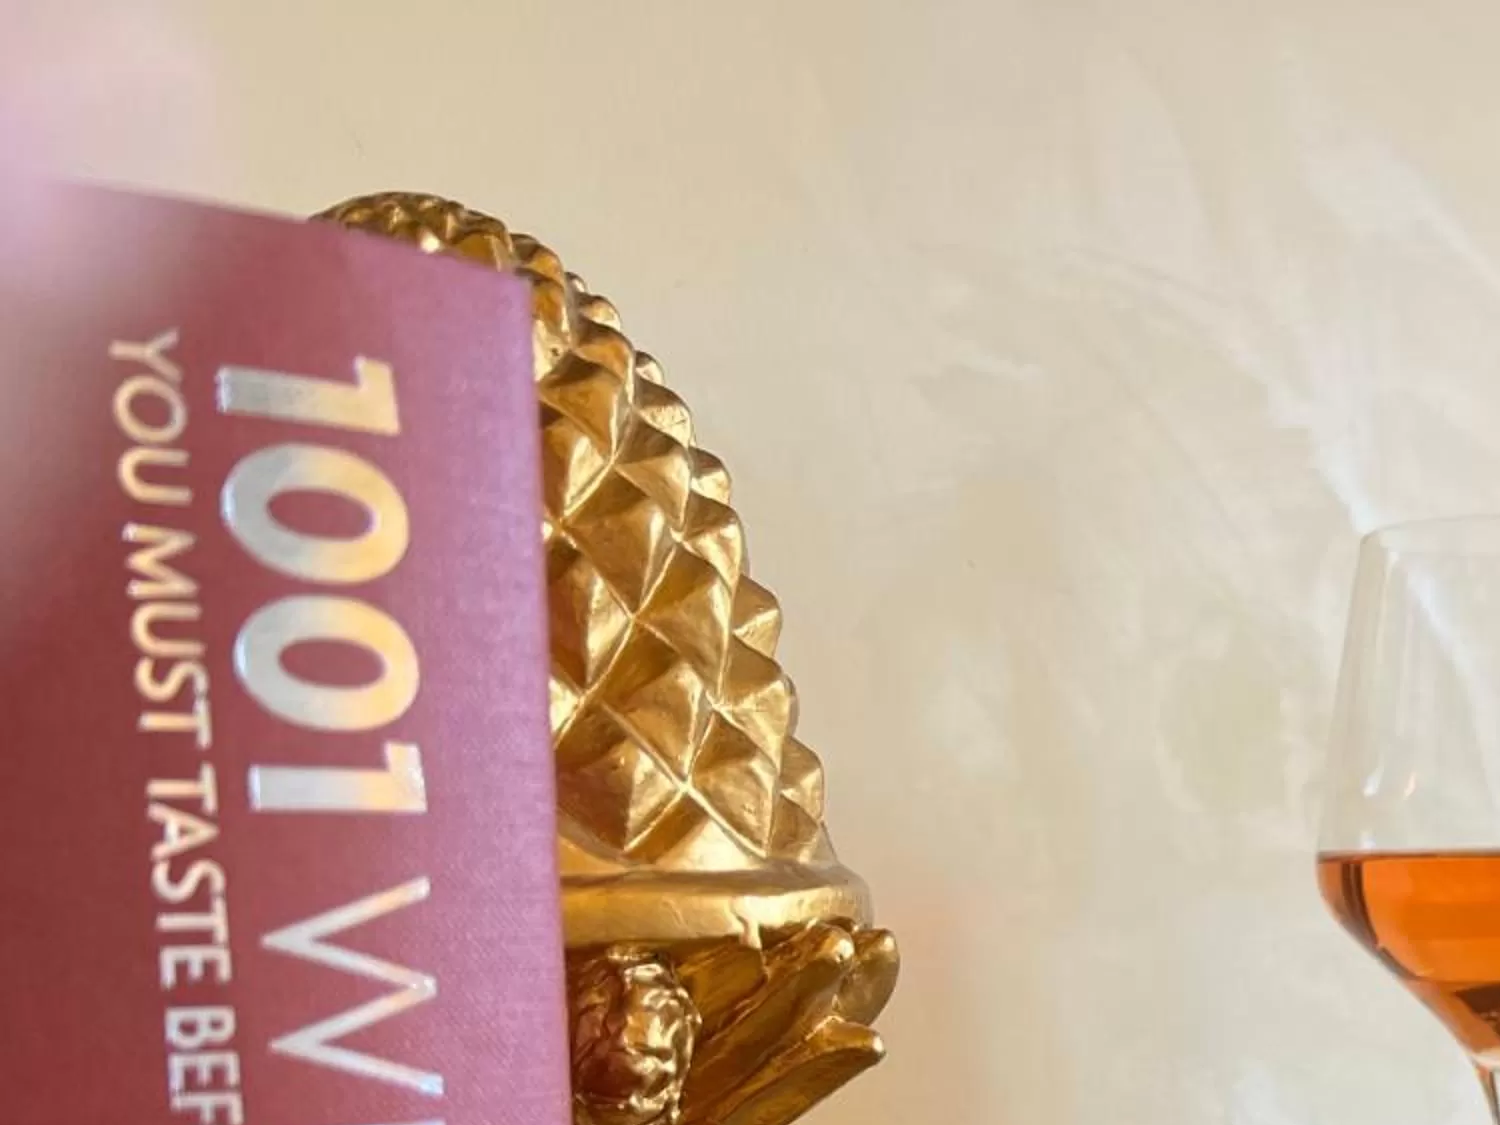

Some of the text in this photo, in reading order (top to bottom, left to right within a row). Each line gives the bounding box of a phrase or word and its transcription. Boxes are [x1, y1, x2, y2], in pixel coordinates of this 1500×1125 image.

[108, 327, 193, 507] YOU
[122, 521, 212, 749] MUST
[216, 355, 427, 814] 1001
[146, 763, 233, 991] TASTE
